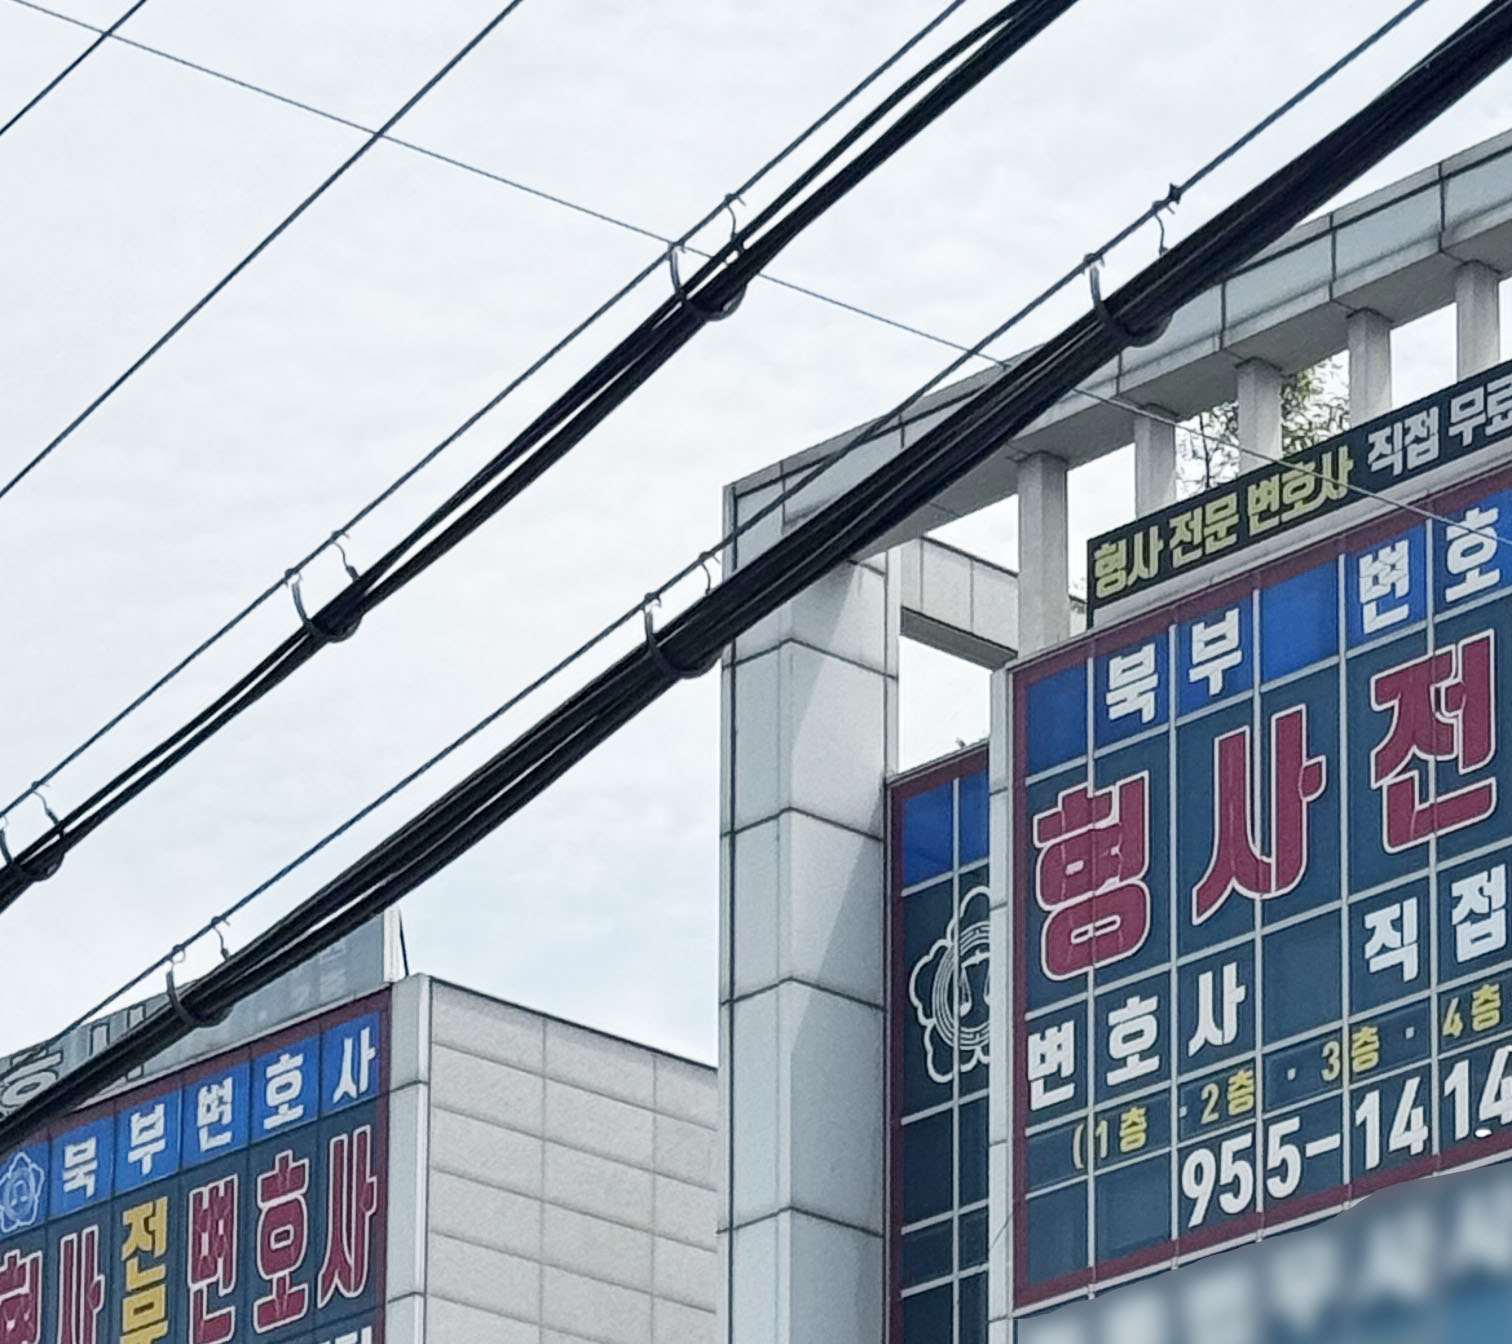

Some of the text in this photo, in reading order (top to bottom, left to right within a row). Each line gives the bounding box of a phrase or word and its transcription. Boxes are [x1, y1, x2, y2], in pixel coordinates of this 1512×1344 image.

[1093, 533, 1163, 600] 형사
[1169, 501, 1240, 565] 전문
[1246, 446, 1354, 533] 변호사
[1366, 409, 1440, 477] 직접
[1106, 606, 1243, 726] 북부
[1026, 962, 1247, 1112] 변호사
